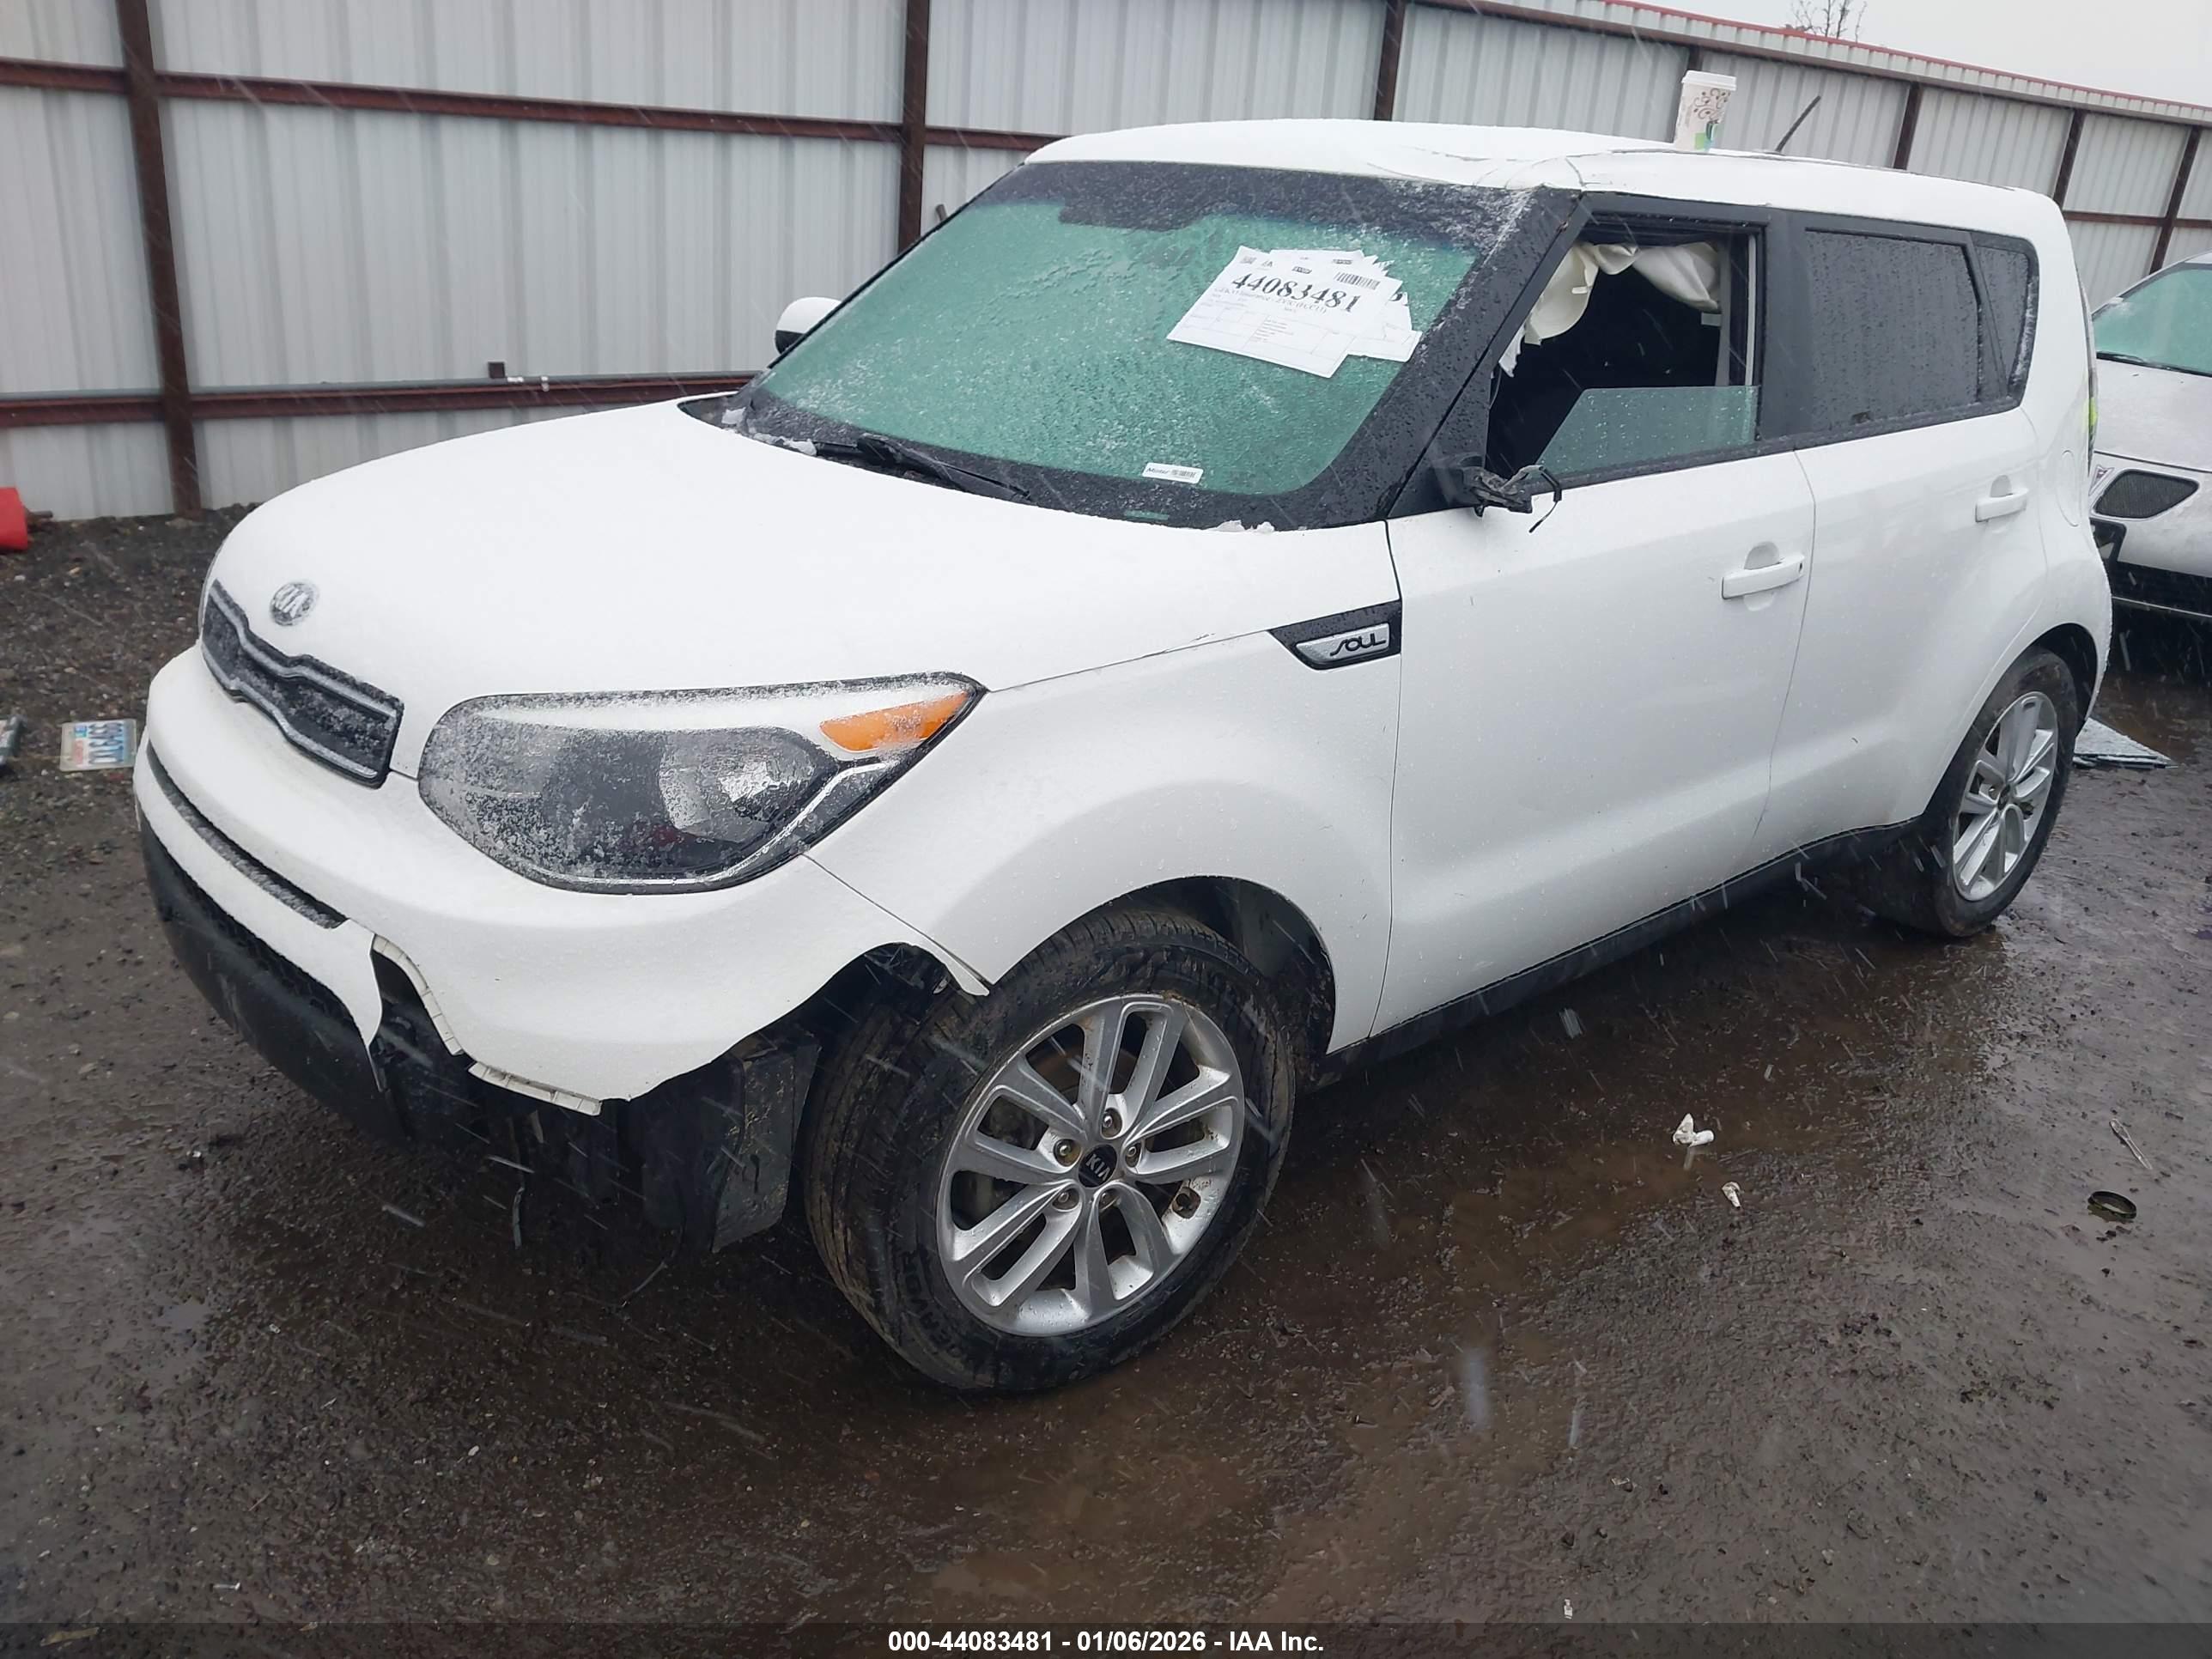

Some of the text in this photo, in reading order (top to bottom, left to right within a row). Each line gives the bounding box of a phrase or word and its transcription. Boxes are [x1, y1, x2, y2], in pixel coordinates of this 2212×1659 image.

[1231, 272, 1361, 313] 44083481
[1330, 633, 1387, 657] SOUL
[1085, 1153, 1110, 1182] KIA
